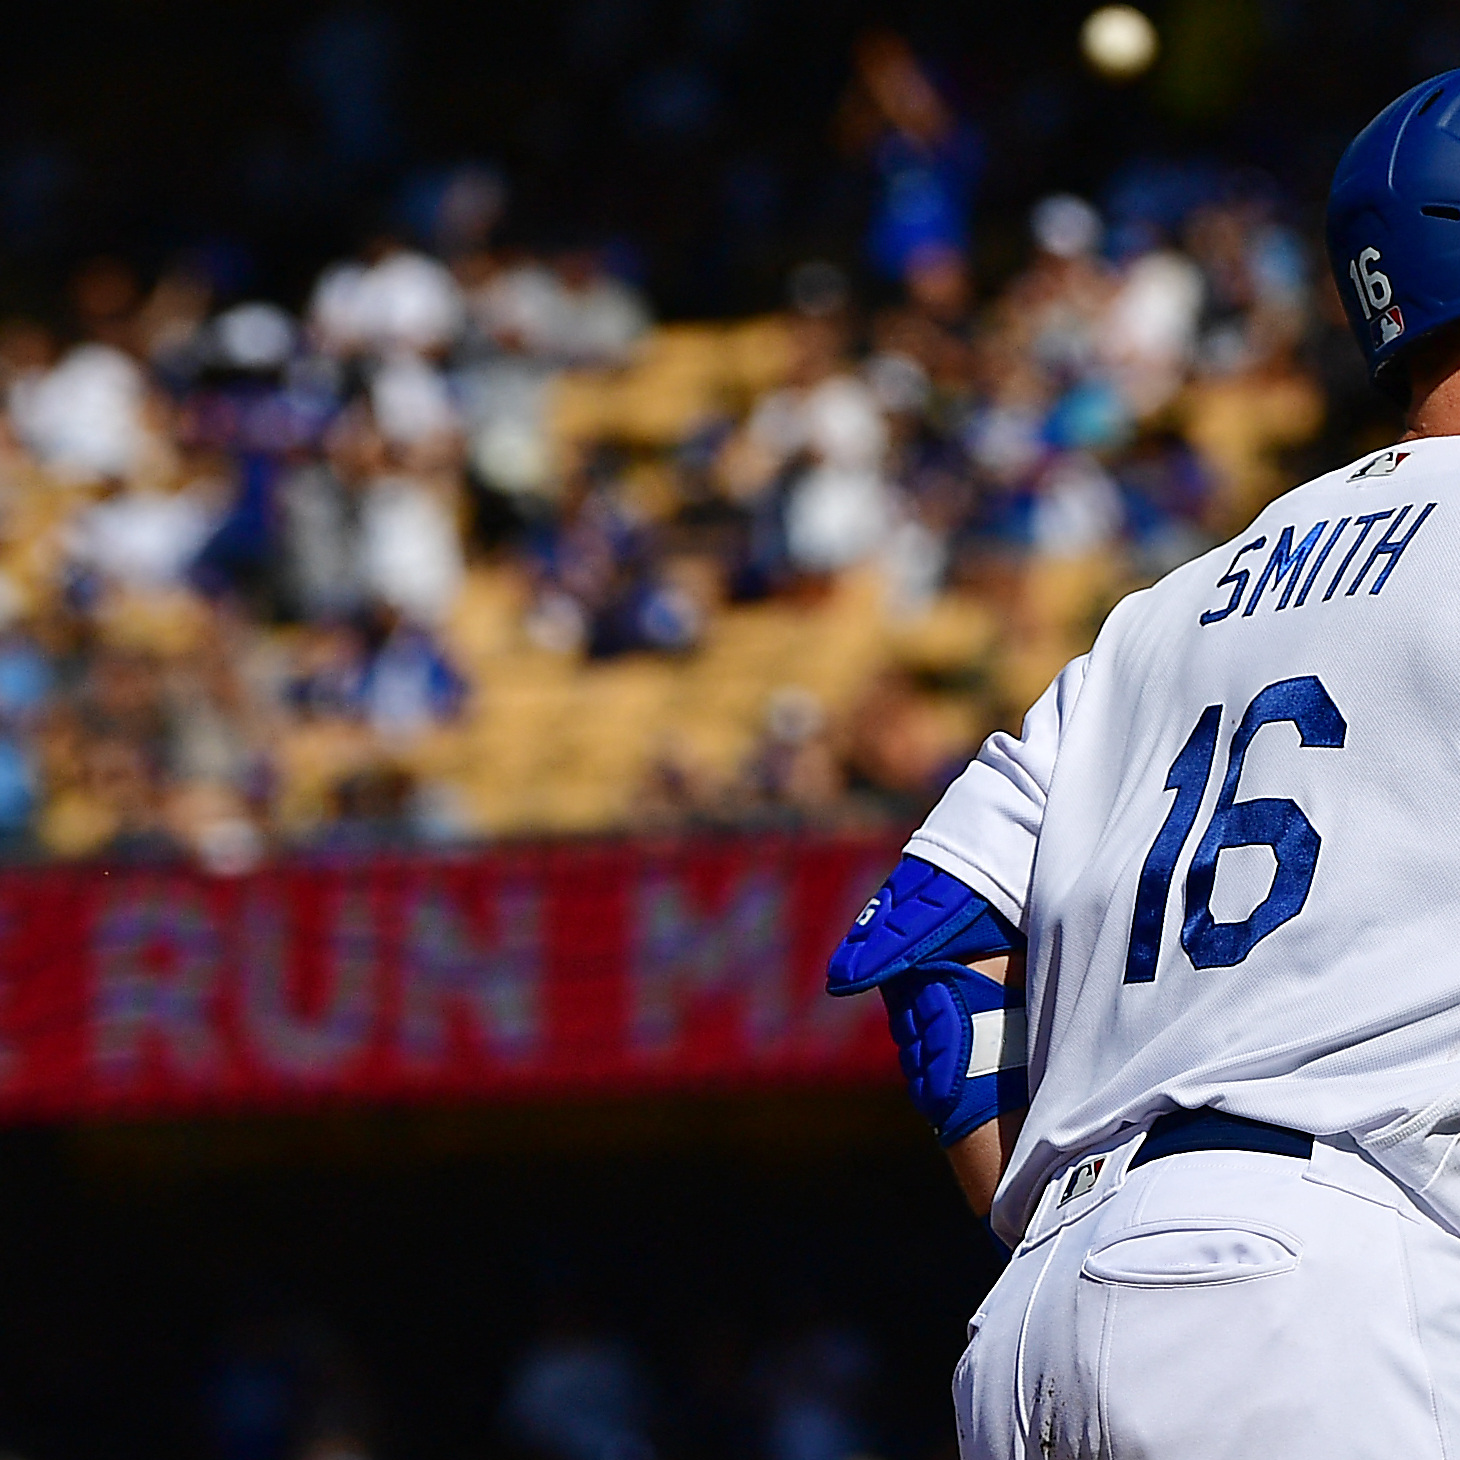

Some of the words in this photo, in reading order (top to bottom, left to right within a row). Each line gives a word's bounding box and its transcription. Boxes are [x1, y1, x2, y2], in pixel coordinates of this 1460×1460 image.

[1349, 246, 1392, 320] 16
[1198, 502, 1438, 627] SMITH
[1123, 674, 1348, 985] 16
[90, 882, 546, 1086] RUN
